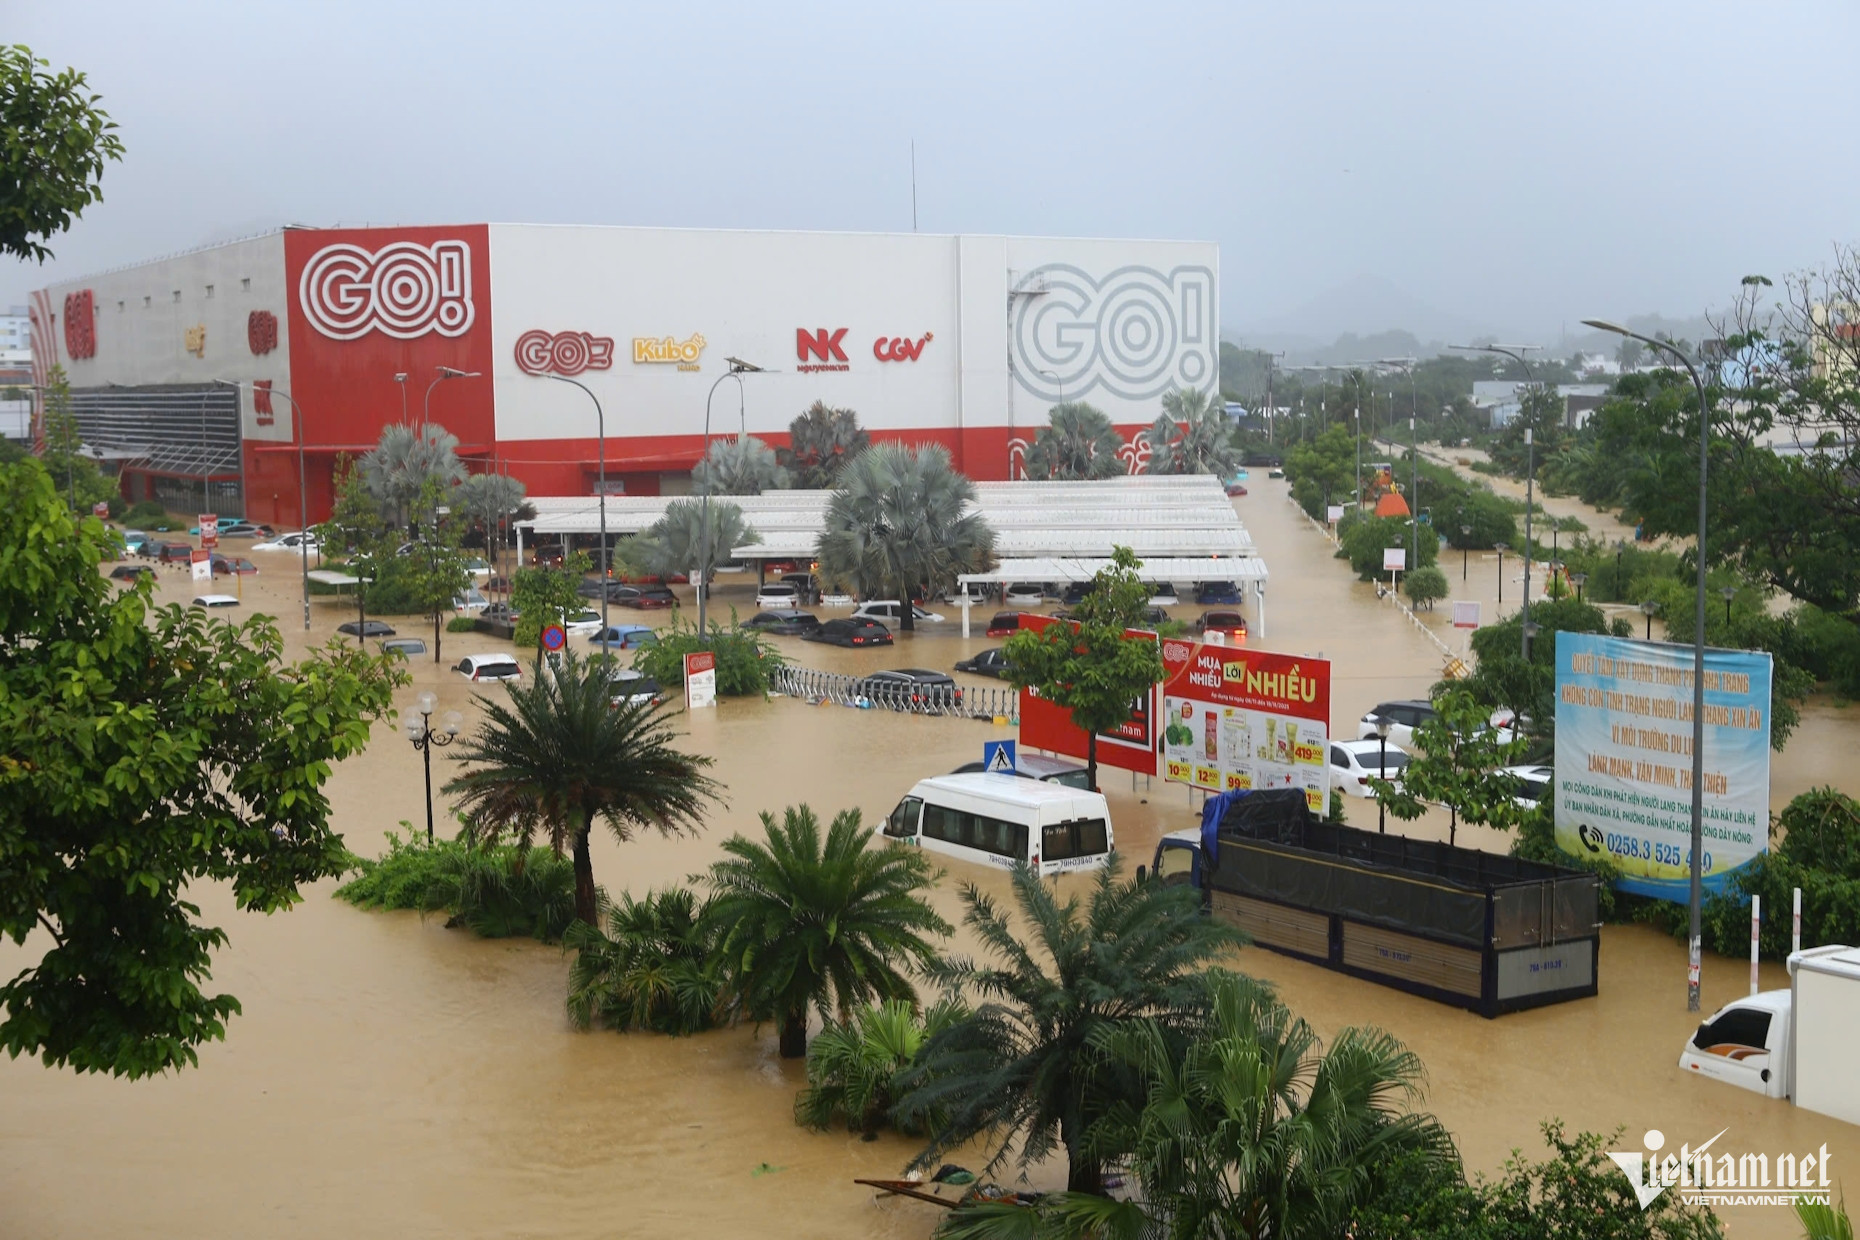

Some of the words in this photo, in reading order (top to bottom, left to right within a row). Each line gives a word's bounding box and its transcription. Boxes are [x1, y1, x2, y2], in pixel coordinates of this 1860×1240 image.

[299, 240, 475, 340] GO!
[797, 328, 849, 362] NK
[873, 337, 926, 362] CGV
[1008, 263, 1219, 401] GO!
[514, 329, 615, 376] GO!
[1189, 667, 1222, 688] NHIỀU
[1225, 666, 1241, 680] LỜI
[1247, 664, 1316, 703] NHIỀU
[1572, 650, 1594, 675] QUYẾT
[1683, 667, 1695, 688] PH
[1703, 670, 1720, 691] NHA
[1721, 671, 1749, 694] TRANG
[1561, 683, 1586, 705] KHÔNG
[1652, 696, 1676, 720] NGƯỜI
[1678, 701, 1694, 722] LAN
[1703, 704, 1729, 727] THANG
[1731, 706, 1746, 729] XIN
[1295, 746, 1312, 760] 419
[1638, 727, 1669, 752] TRƯỜNG
[1671, 733, 1682, 754] DU
[1169, 764, 1180, 776] 10
[1198, 769, 1209, 782] 12
[1703, 770, 1727, 798] THIỆN
[1562, 780, 1573, 794] MỌI
[1574, 781, 1590, 795] CÔNG
[1591, 784, 1602, 798] DÂN
[1603, 786, 1612, 799] KHI
[1613, 787, 1627, 802] PHÁT
[1628, 790, 1640, 807] HIỆN
[1641, 794, 1659, 810] NGƯỜI
[1660, 799, 1676, 812] LANG
[1677, 802, 1692, 815] THAN
[1734, 809, 1746, 825] LIÊN
[1748, 811, 1756, 828] HỆ
[1572, 800, 1583, 812] BAN
[1584, 801, 1599, 816] NHÂN
[1600, 804, 1611, 818] DÂN
[1622, 809, 1645, 825] PHƯỜNG
[1701, 822, 1718, 838] ƯỜNG
[1719, 826, 1731, 841] DÂY
[1607, 833, 1651, 860] 0258.3
[1655, 842, 1680, 866] 525
[1685, 848, 1712, 872] 40
